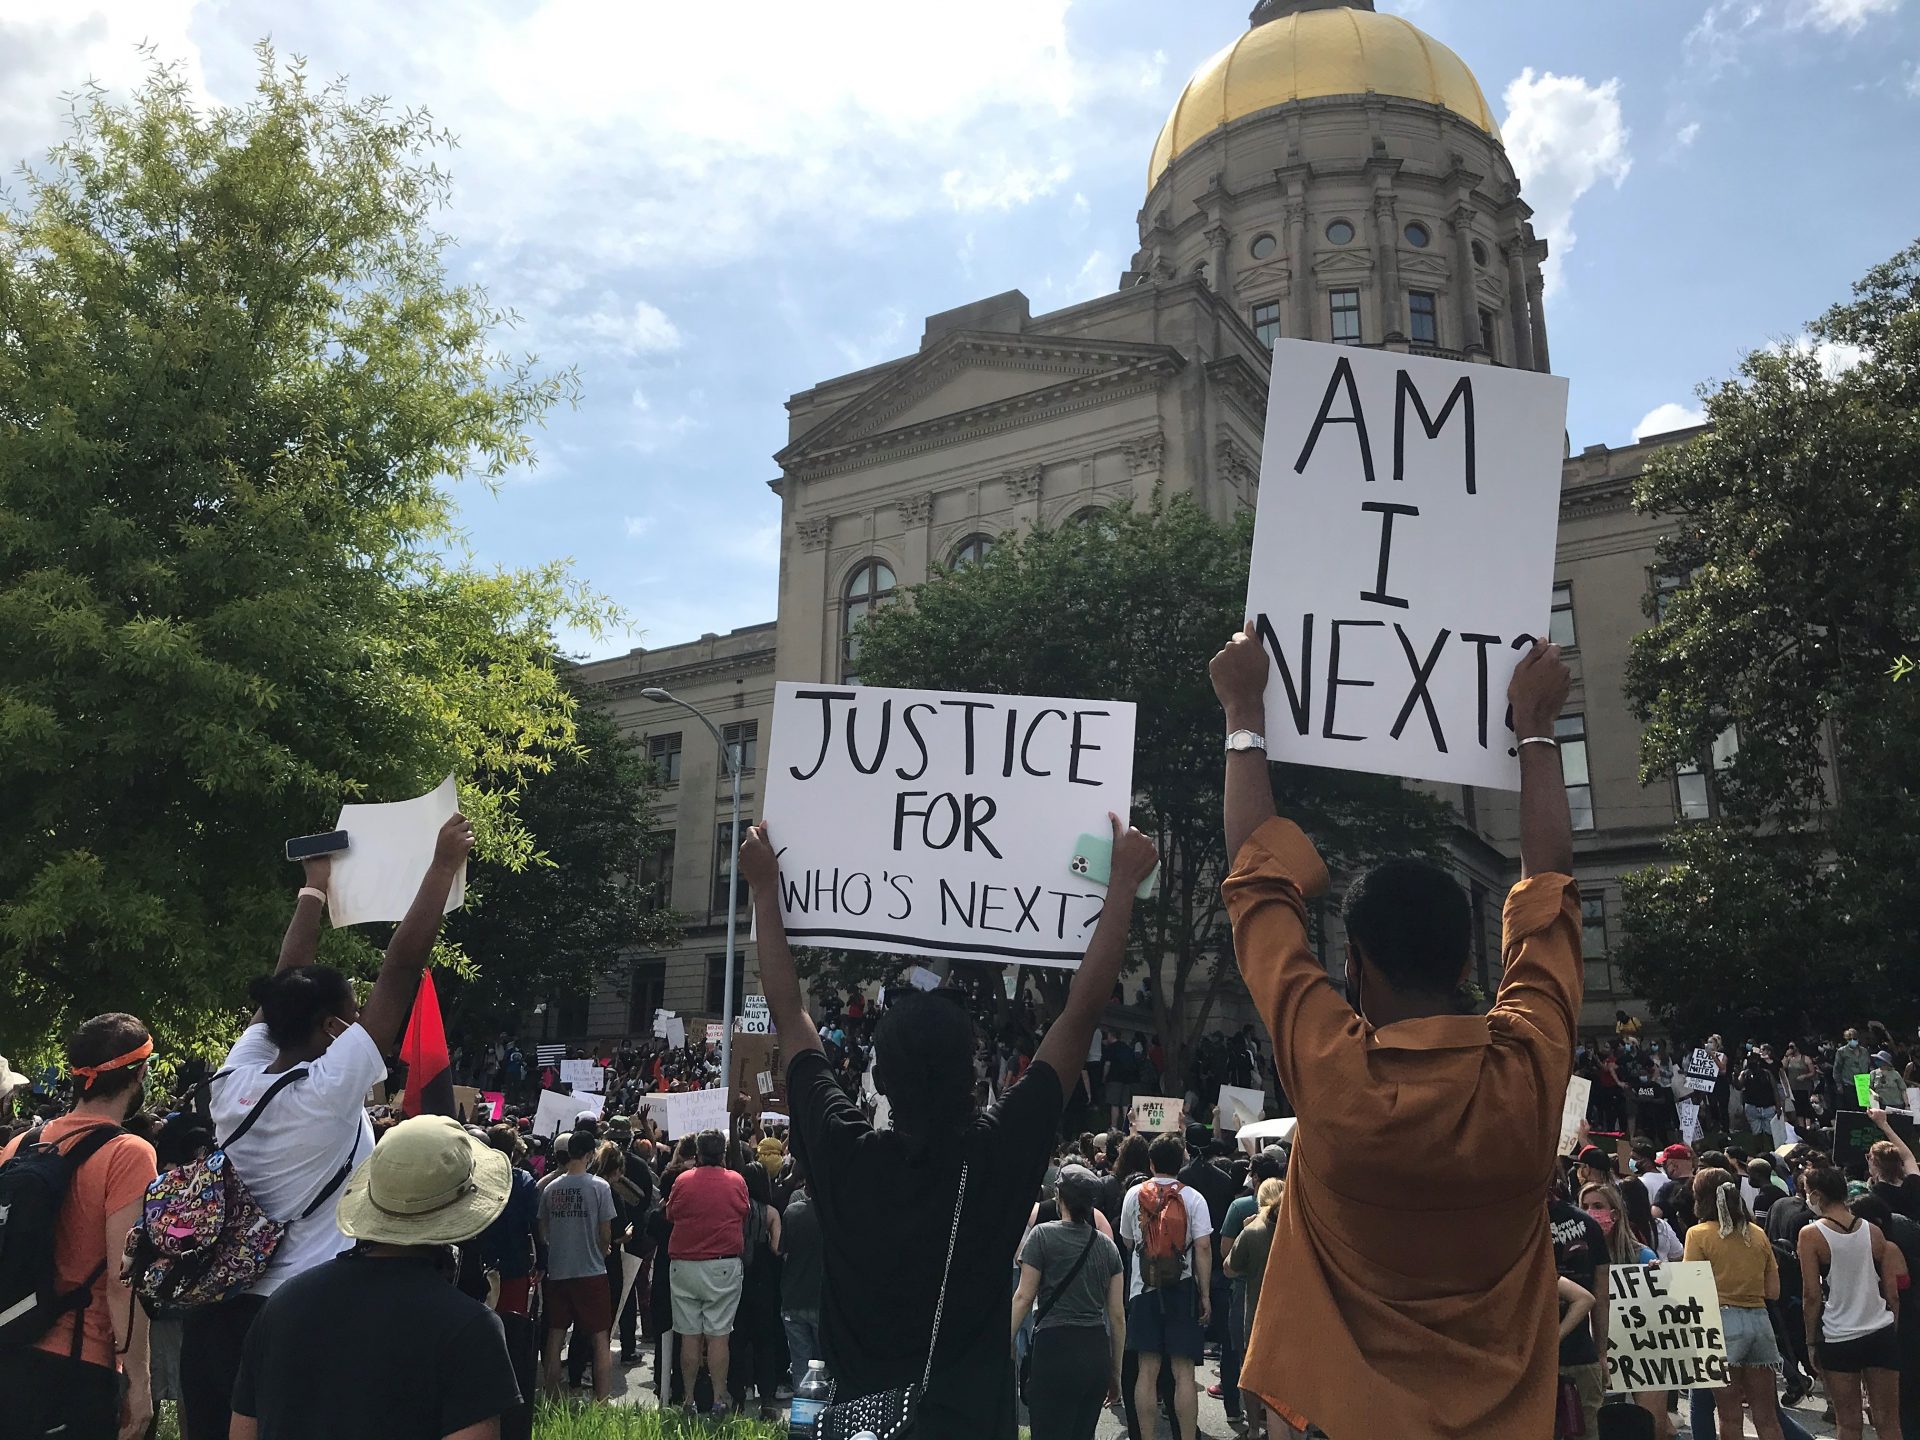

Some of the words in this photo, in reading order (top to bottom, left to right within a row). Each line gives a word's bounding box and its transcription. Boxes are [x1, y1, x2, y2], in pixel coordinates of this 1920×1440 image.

[1293, 356, 1477, 495] AM
[1360, 501, 1420, 609] I
[789, 690, 1111, 787] JUSTICE
[893, 791, 1003, 859] FOR
[779, 867, 914, 920] WHO'S
[939, 878, 1106, 939] NEXT?
[745, 1010, 768, 1019] MUST
[1689, 1065, 1715, 1077] MATTER
[1691, 1057, 1714, 1069] LIVES
[1142, 1102, 1164, 1111] #ATL
[1147, 1110, 1164, 1118] FOR
[1150, 1118, 1161, 1126] US
[1617, 1305, 1647, 1329] is
[1658, 1296, 1704, 1325] not
[1629, 1326, 1723, 1351] WHITE
